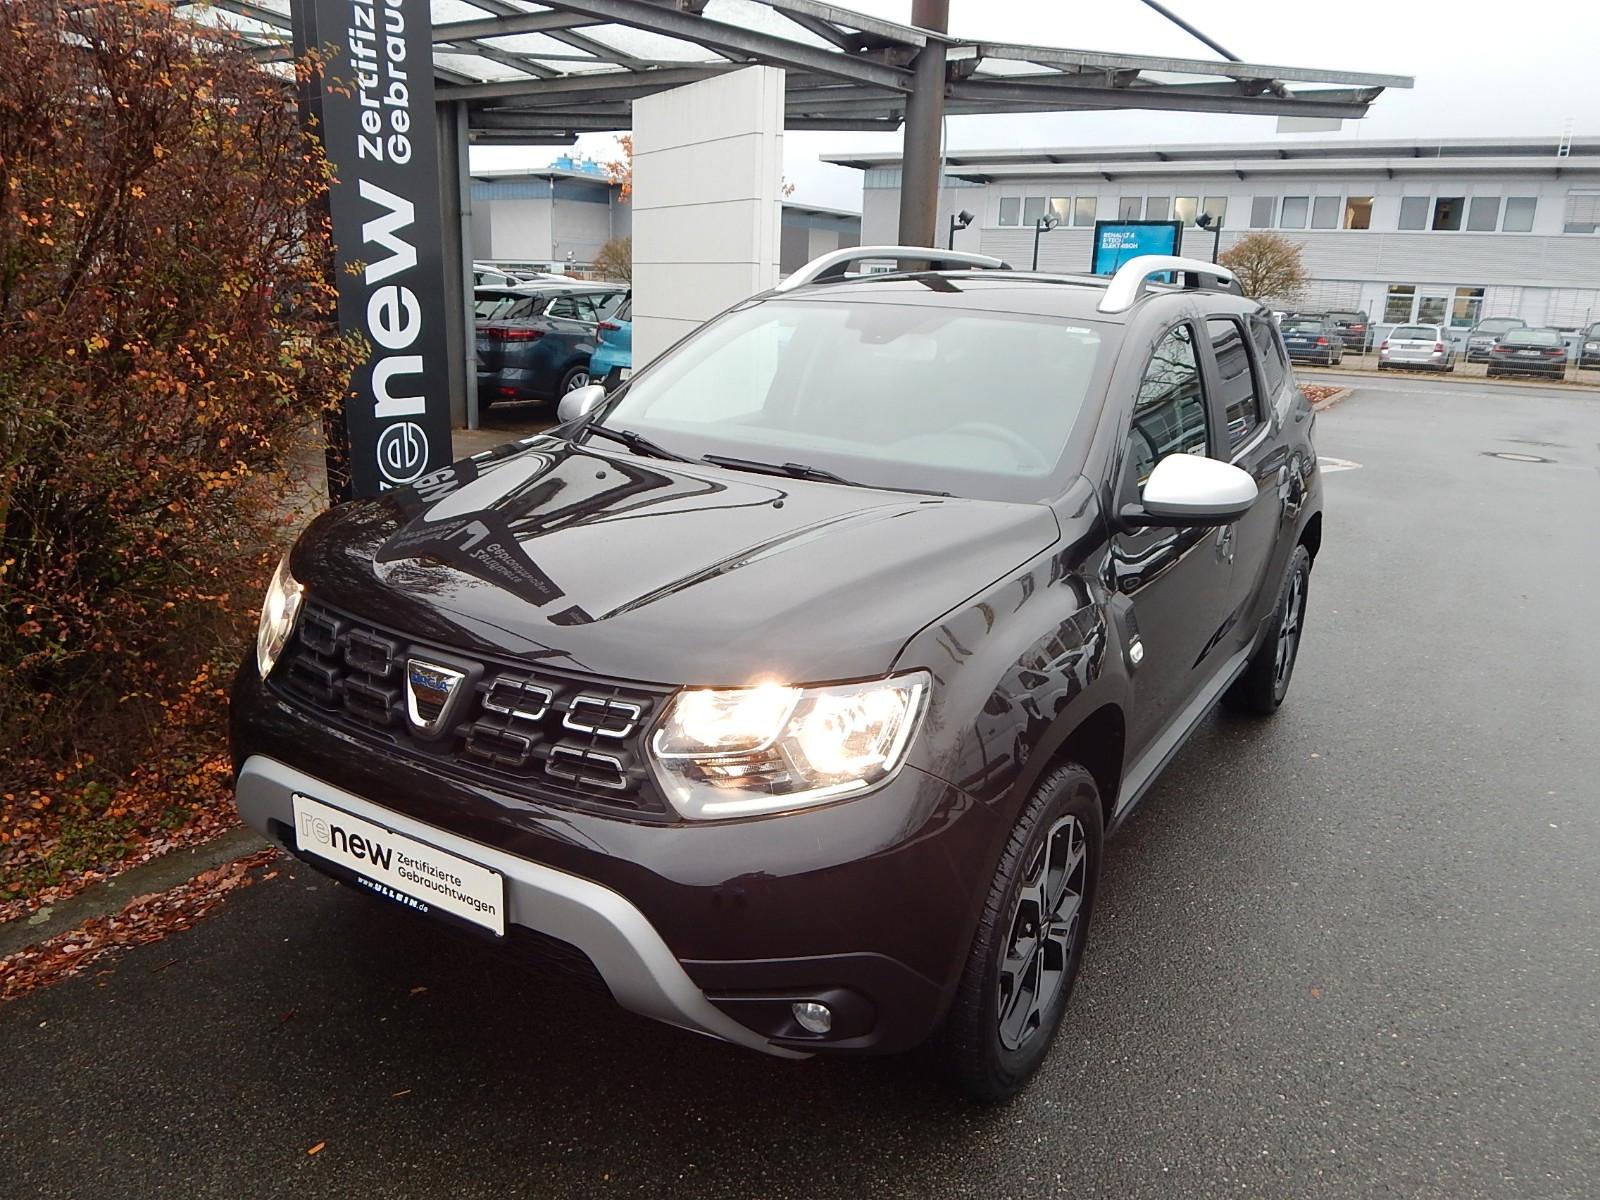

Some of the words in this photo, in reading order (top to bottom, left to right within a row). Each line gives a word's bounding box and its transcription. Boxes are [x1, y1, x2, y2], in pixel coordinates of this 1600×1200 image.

[358, 178, 429, 491] enew
[300, 811, 393, 871] renew
[396, 851, 462, 887] Zertifizierte
[398, 866, 496, 916] Gebrauchtwagen
